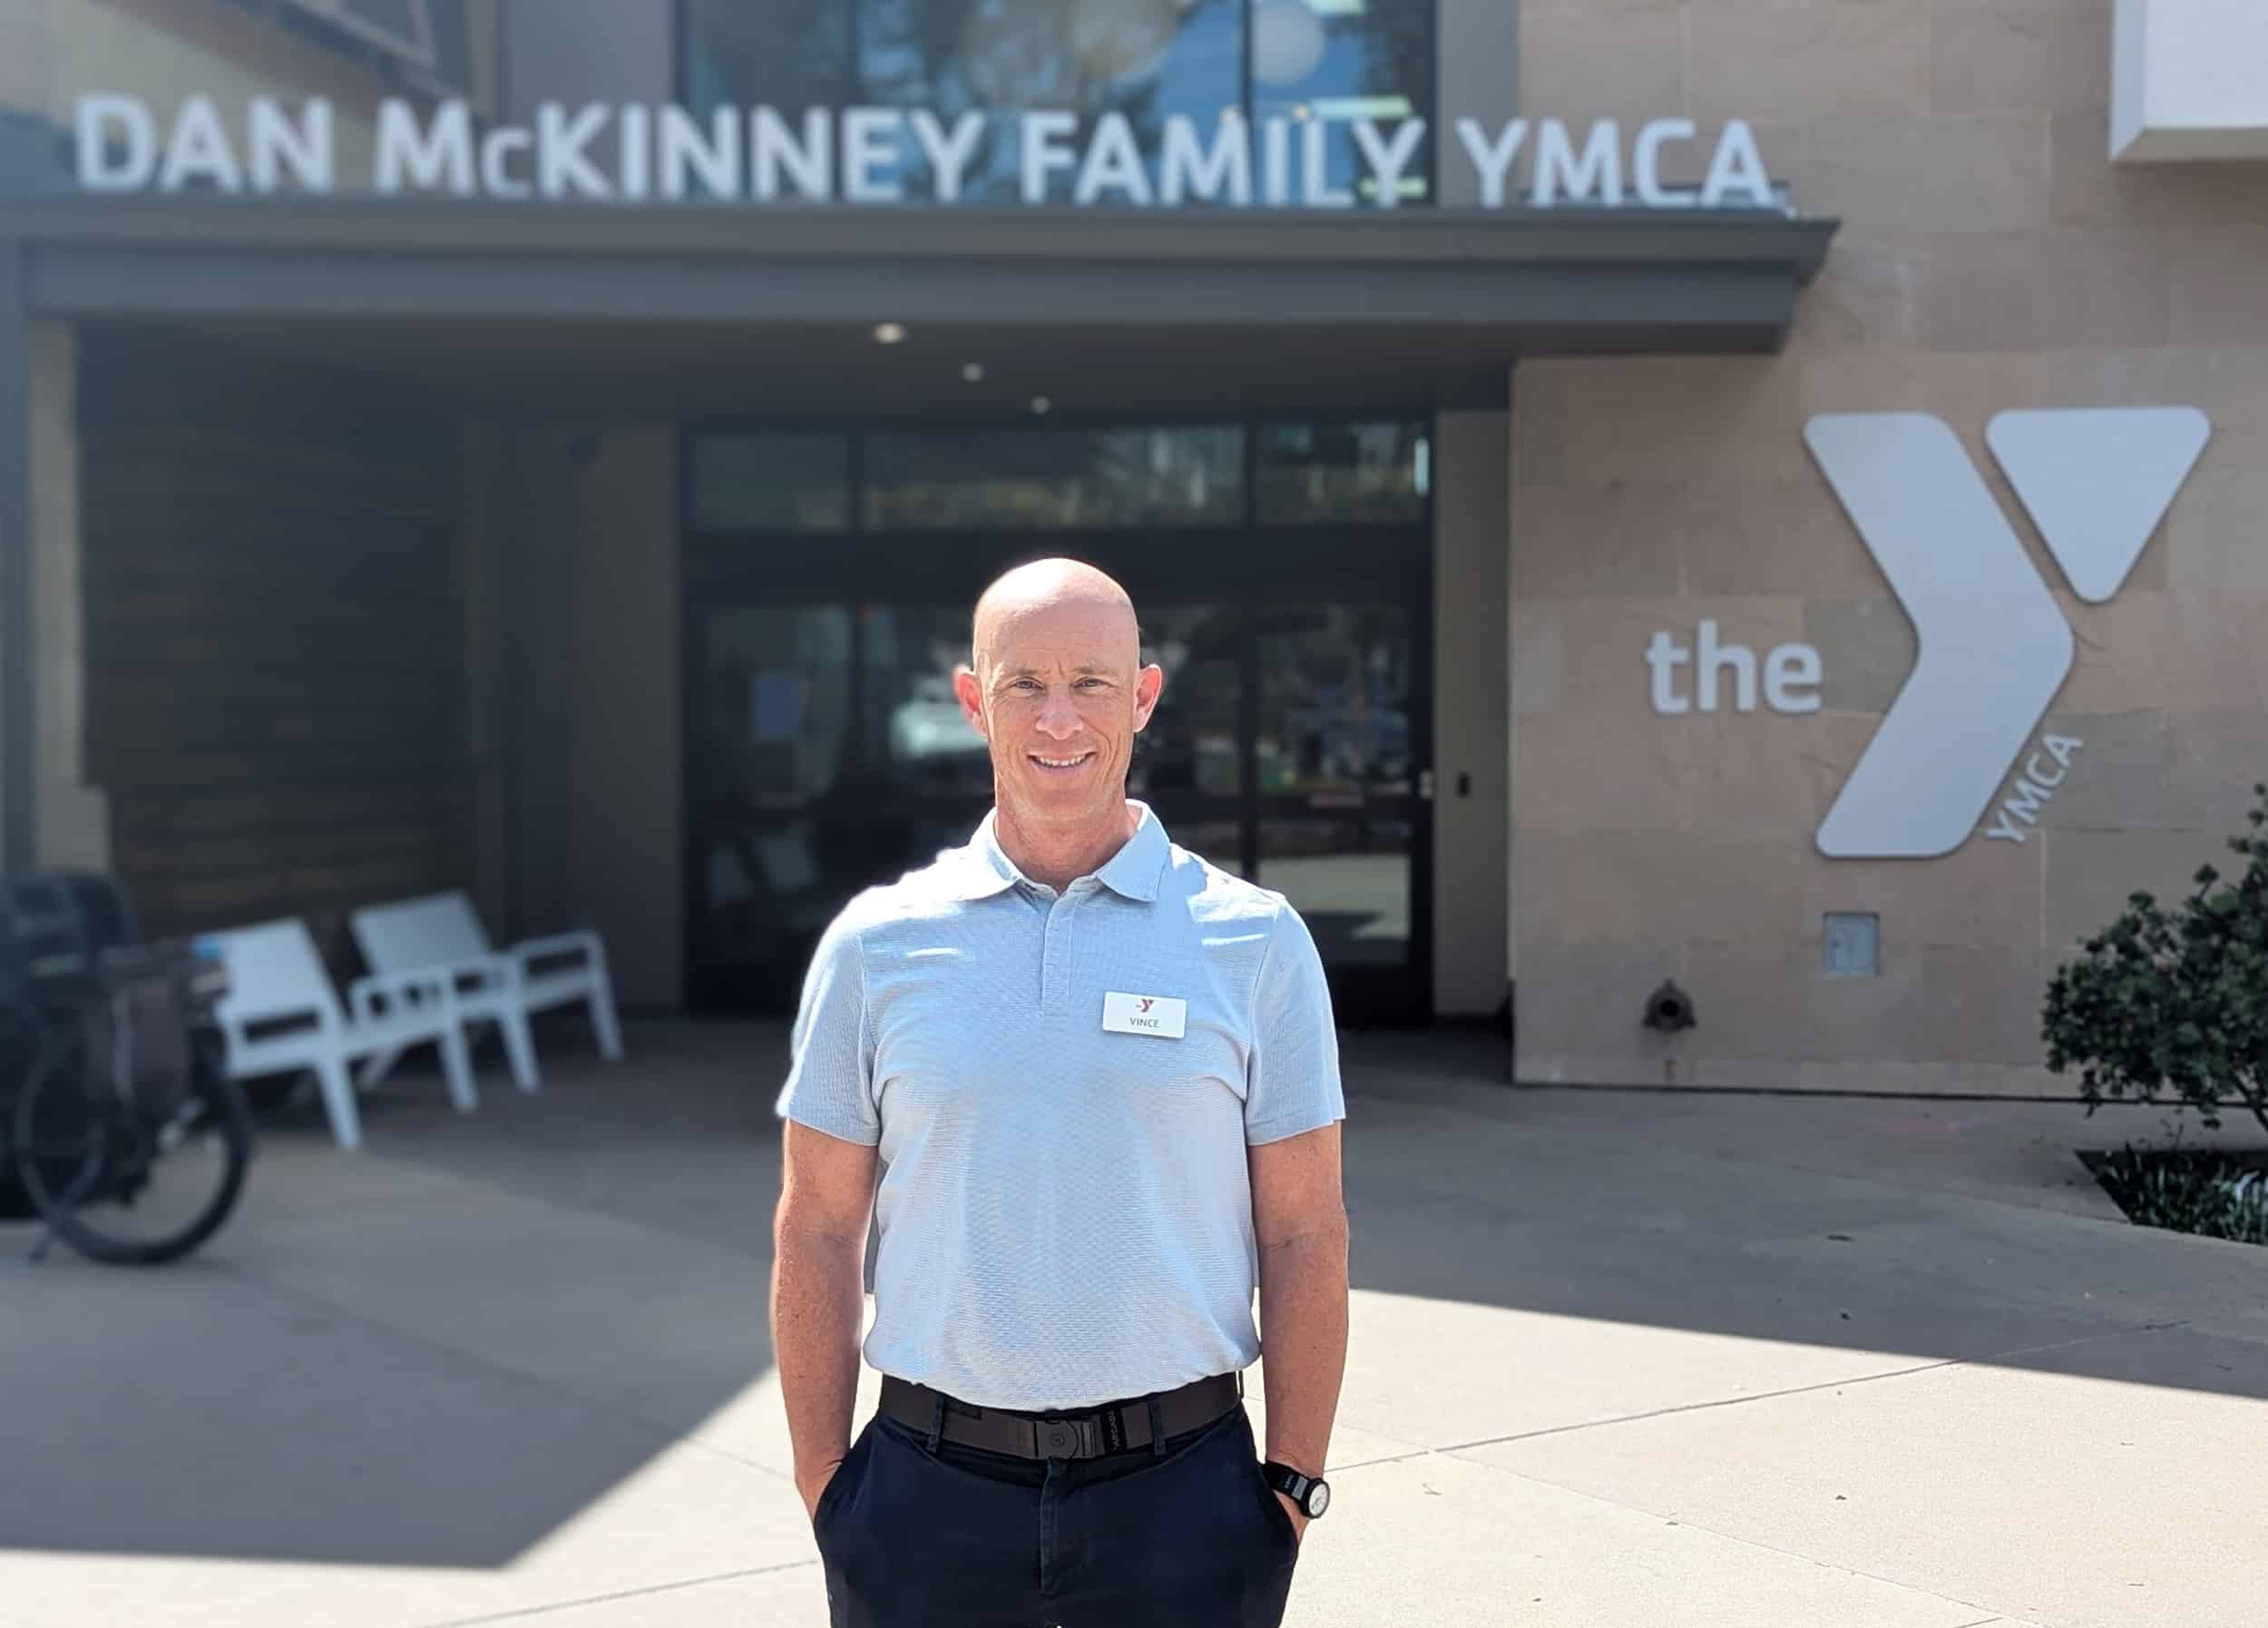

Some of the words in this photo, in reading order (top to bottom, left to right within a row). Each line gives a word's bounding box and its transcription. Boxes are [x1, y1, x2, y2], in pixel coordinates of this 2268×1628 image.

[74, 94, 334, 192] DAN
[372, 99, 989, 203] McKINNEY
[1020, 111, 1428, 209] FAMILY
[1455, 118, 1778, 209] YMCA
[1645, 619, 1823, 715] the
[1986, 731, 2084, 847] YMCA
[1129, 1017, 1159, 1027] VINCE
